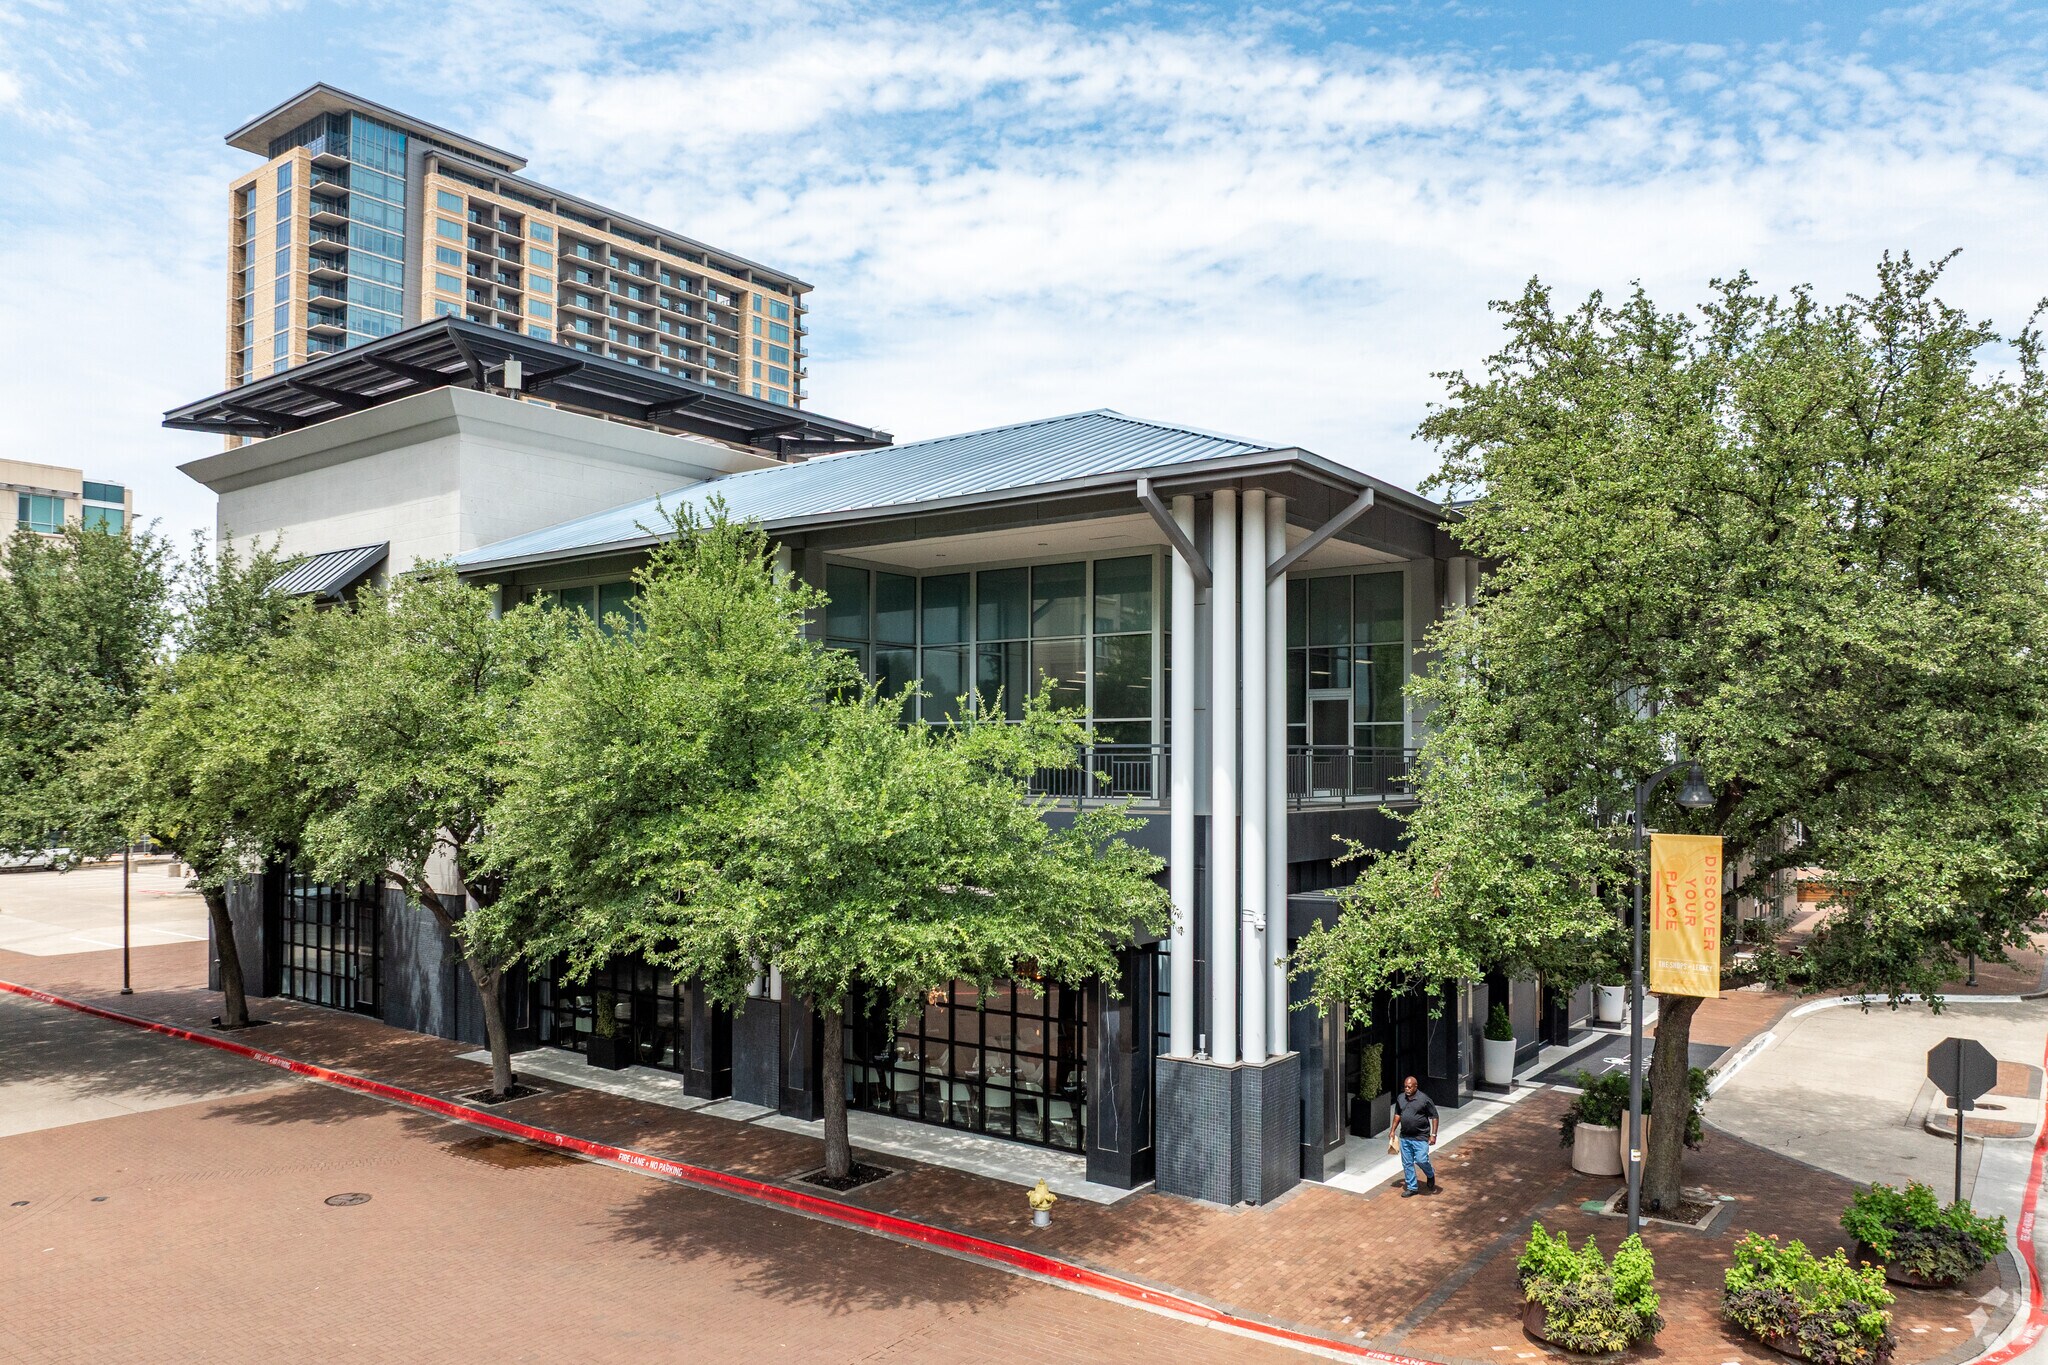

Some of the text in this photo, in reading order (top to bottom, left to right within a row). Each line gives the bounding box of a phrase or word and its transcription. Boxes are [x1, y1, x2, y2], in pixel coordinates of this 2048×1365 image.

[1665, 871, 1678, 931] PLACE
[1684, 878, 1697, 928] YOUR
[1703, 856, 1717, 951] DISCOVER
[618, 1153, 683, 1176] FIRE LANE NO PARKING
[1366, 1351, 1392, 1360] FIRE
